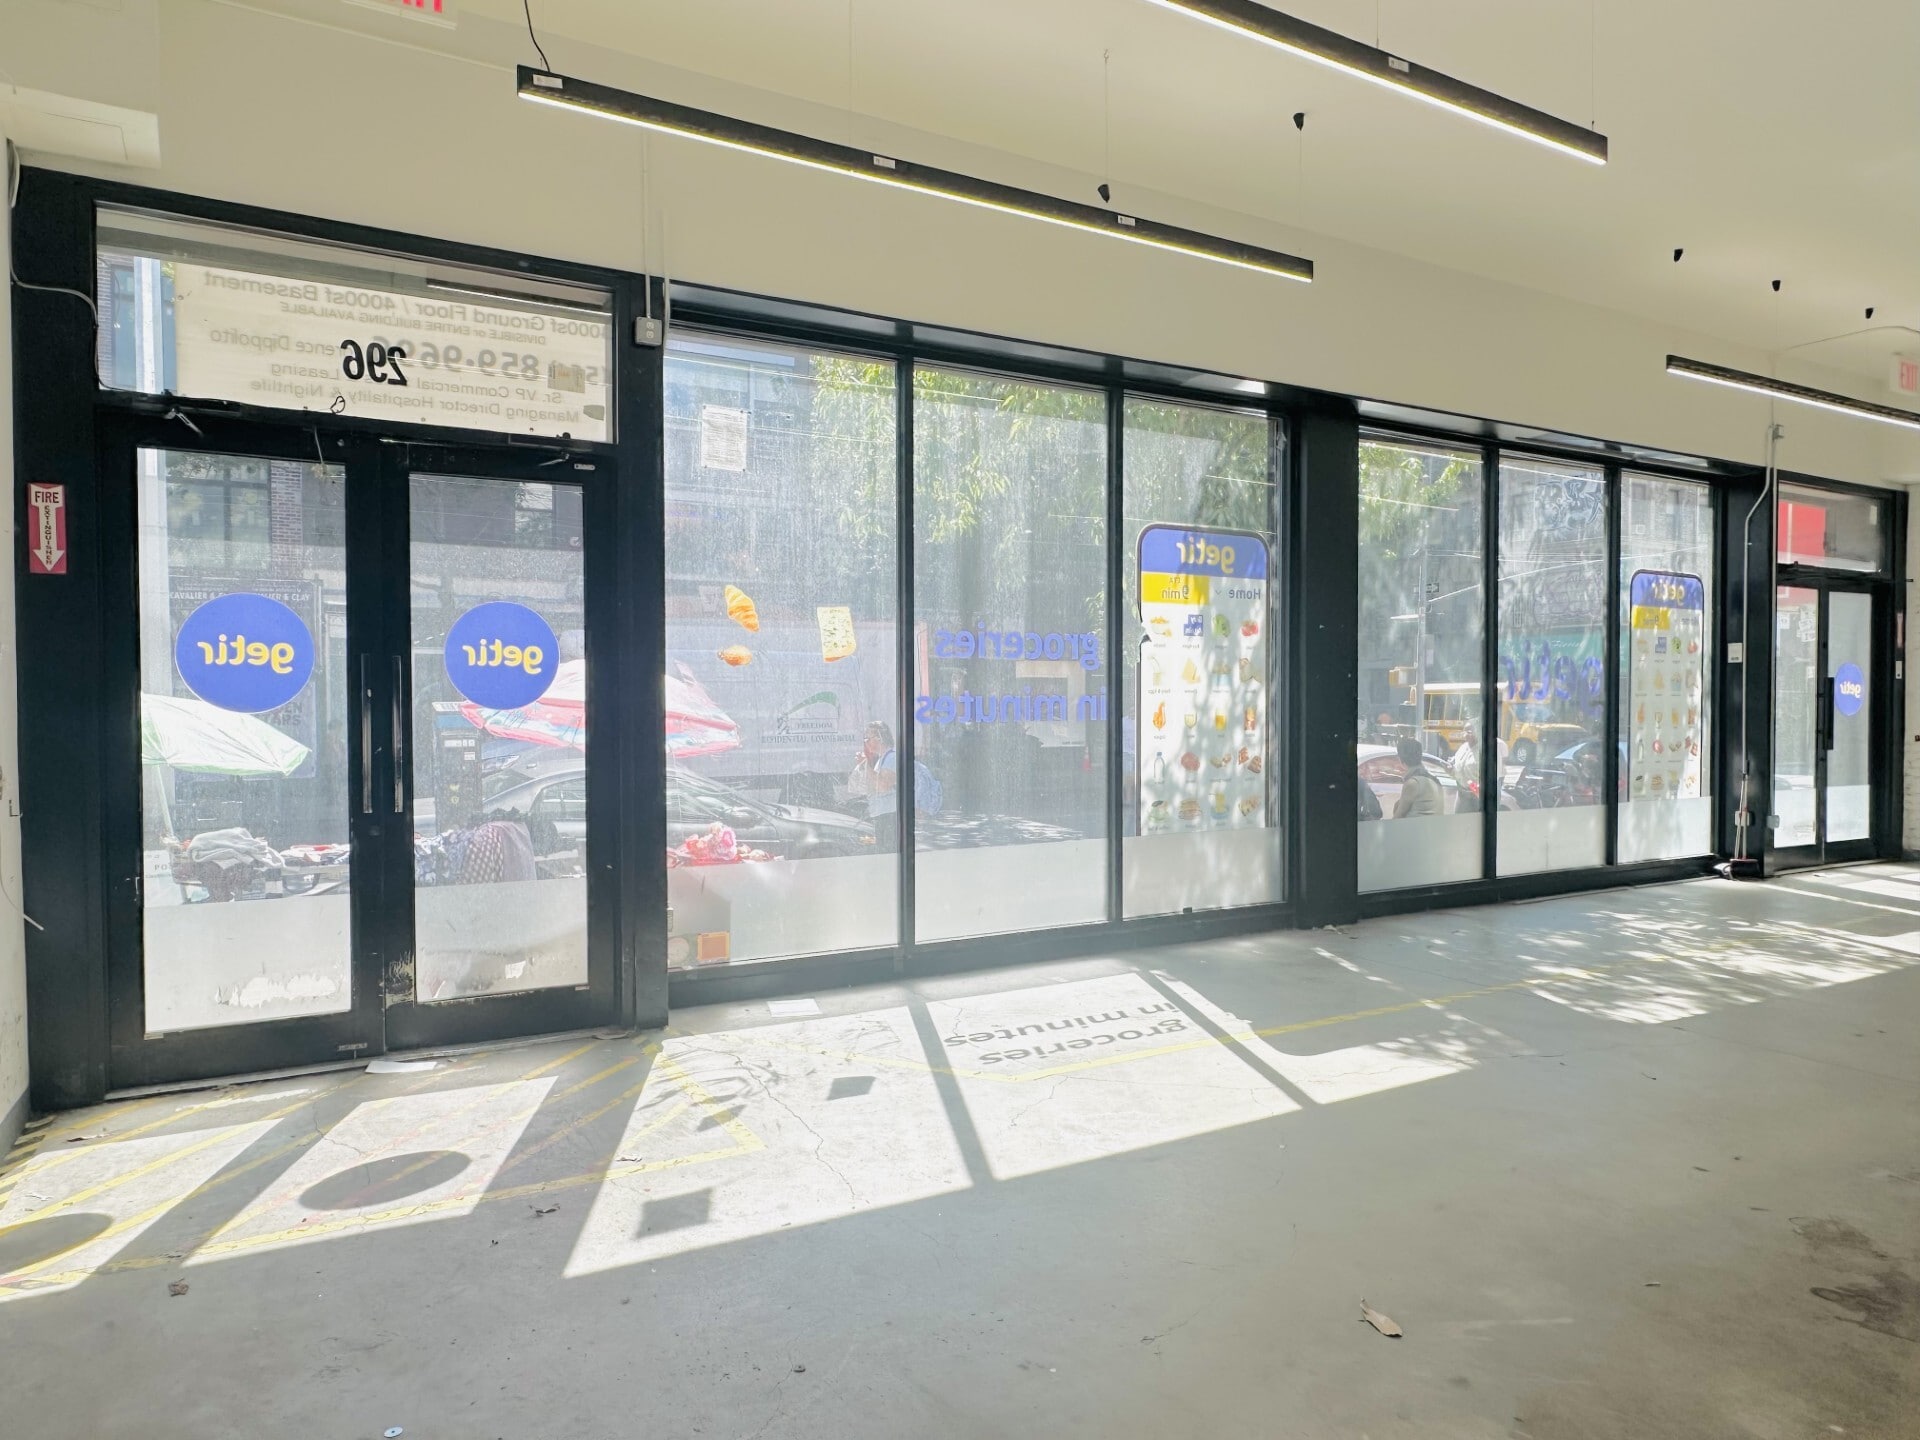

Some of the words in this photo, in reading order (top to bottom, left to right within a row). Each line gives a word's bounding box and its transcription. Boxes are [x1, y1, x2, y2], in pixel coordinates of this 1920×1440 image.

[34, 491, 60, 504] FIRE
[44, 505, 52, 565] EXTINGUISHER
[1139, 1002, 1180, 1014] in
[943, 1010, 1130, 1047] minutes
[979, 1019, 1188, 1065] groceries
